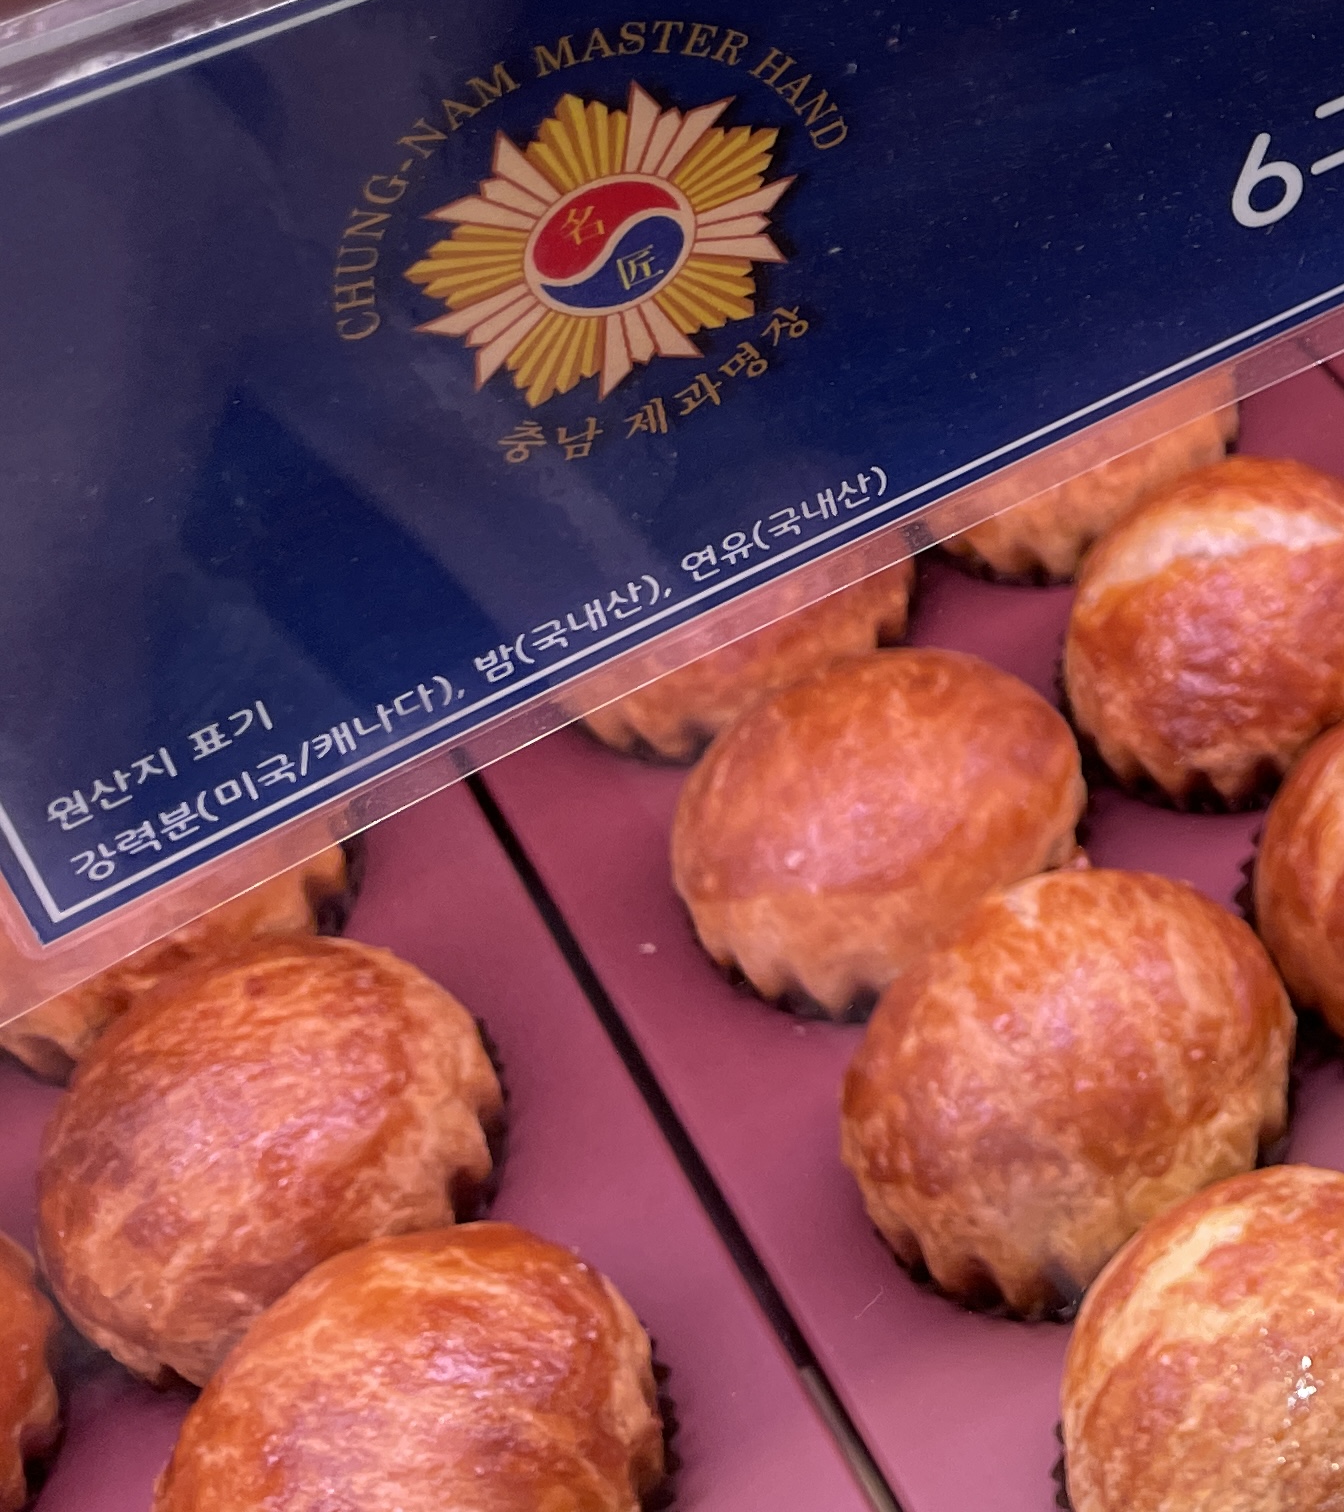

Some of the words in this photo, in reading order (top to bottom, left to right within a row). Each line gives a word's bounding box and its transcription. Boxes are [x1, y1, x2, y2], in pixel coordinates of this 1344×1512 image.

[335, 60, 521, 342] CHUNG-NAM
[533, 19, 750, 78] MASTER
[748, 47, 849, 151] HAND
[562, 205, 605, 246] 名
[616, 243, 665, 291] 匠
[498, 418, 604, 463] 충남
[69, 674, 467, 882] 강력분(미국/캐나다),
[473, 574, 673, 682] 밤(국내산),
[680, 465, 888, 582] 연유(국내산)
[46, 746, 178, 831] 원산지
[187, 700, 274, 761] 표기
